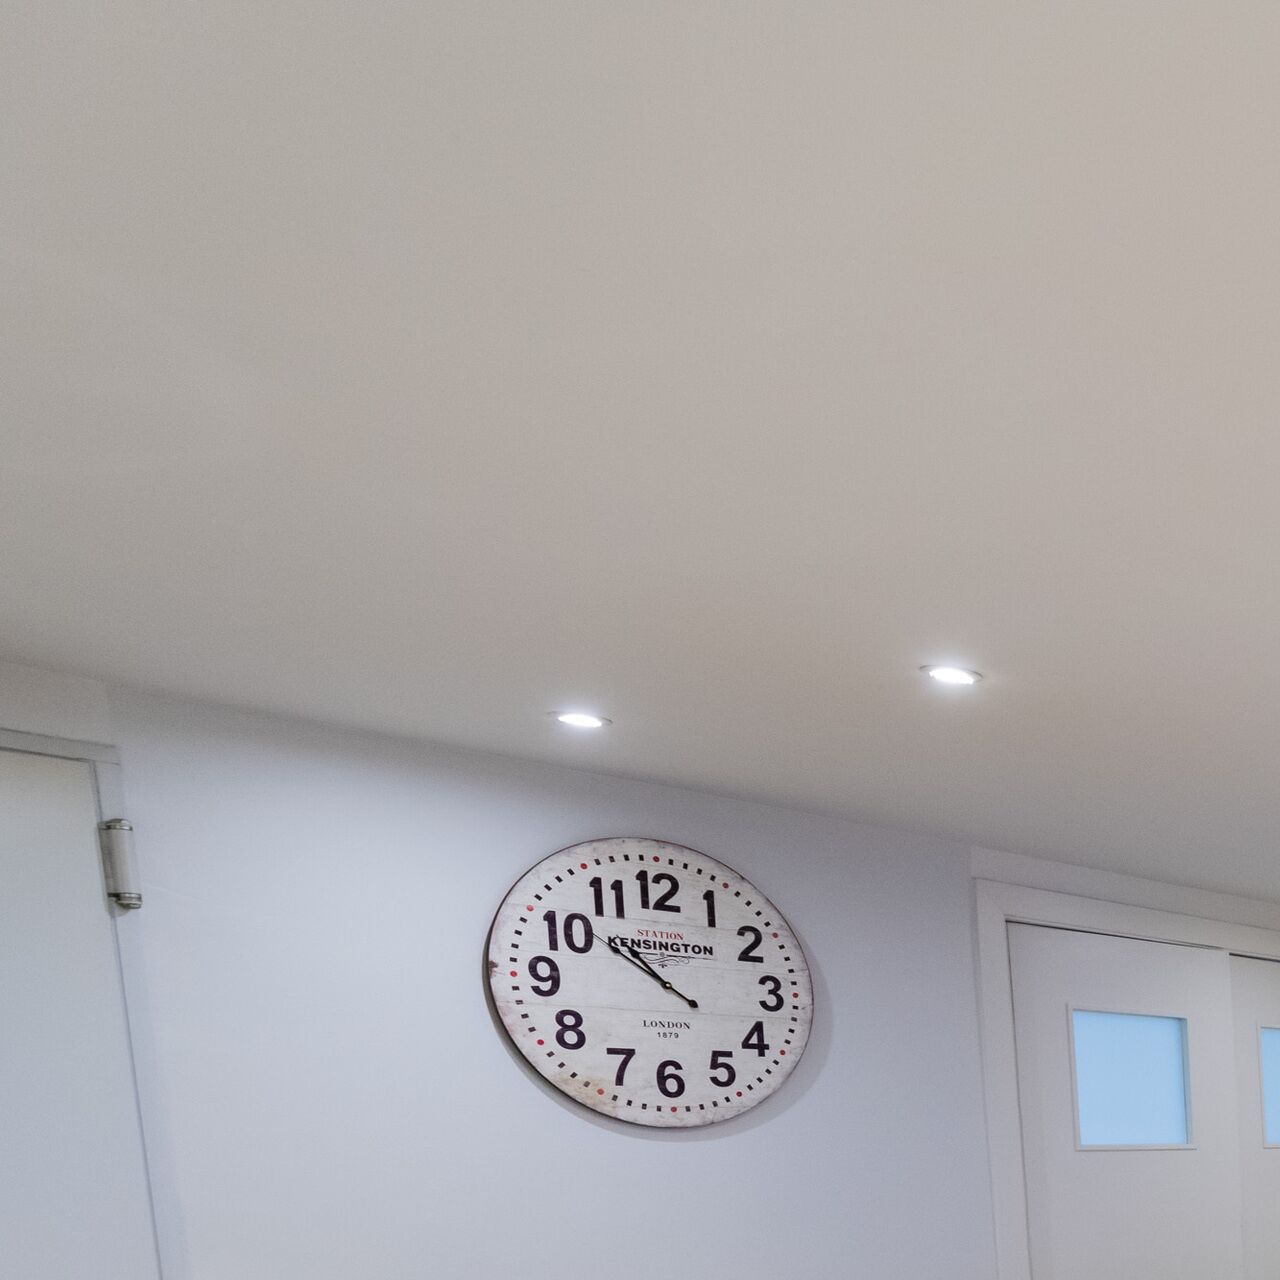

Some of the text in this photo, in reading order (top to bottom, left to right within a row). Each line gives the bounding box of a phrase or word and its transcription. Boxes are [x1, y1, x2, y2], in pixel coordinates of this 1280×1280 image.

[589, 876, 625, 919] 11
[635, 870, 681, 914] 12
[702, 889, 716, 928] 1
[542, 910, 594, 954] 10
[607, 935, 713, 956] KENSINGTON
[637, 929, 683, 940] STATION
[736, 925, 764, 964] 2
[527, 955, 561, 998] 9
[758, 975, 784, 1012] 3
[554, 1009, 586, 1051] 8
[643, 1020, 690, 1029] LONDON
[741, 1020, 769, 1058] 4
[606, 1047, 636, 1087] 7
[656, 1059, 686, 1099] 6
[709, 1049, 737, 1088] 5
